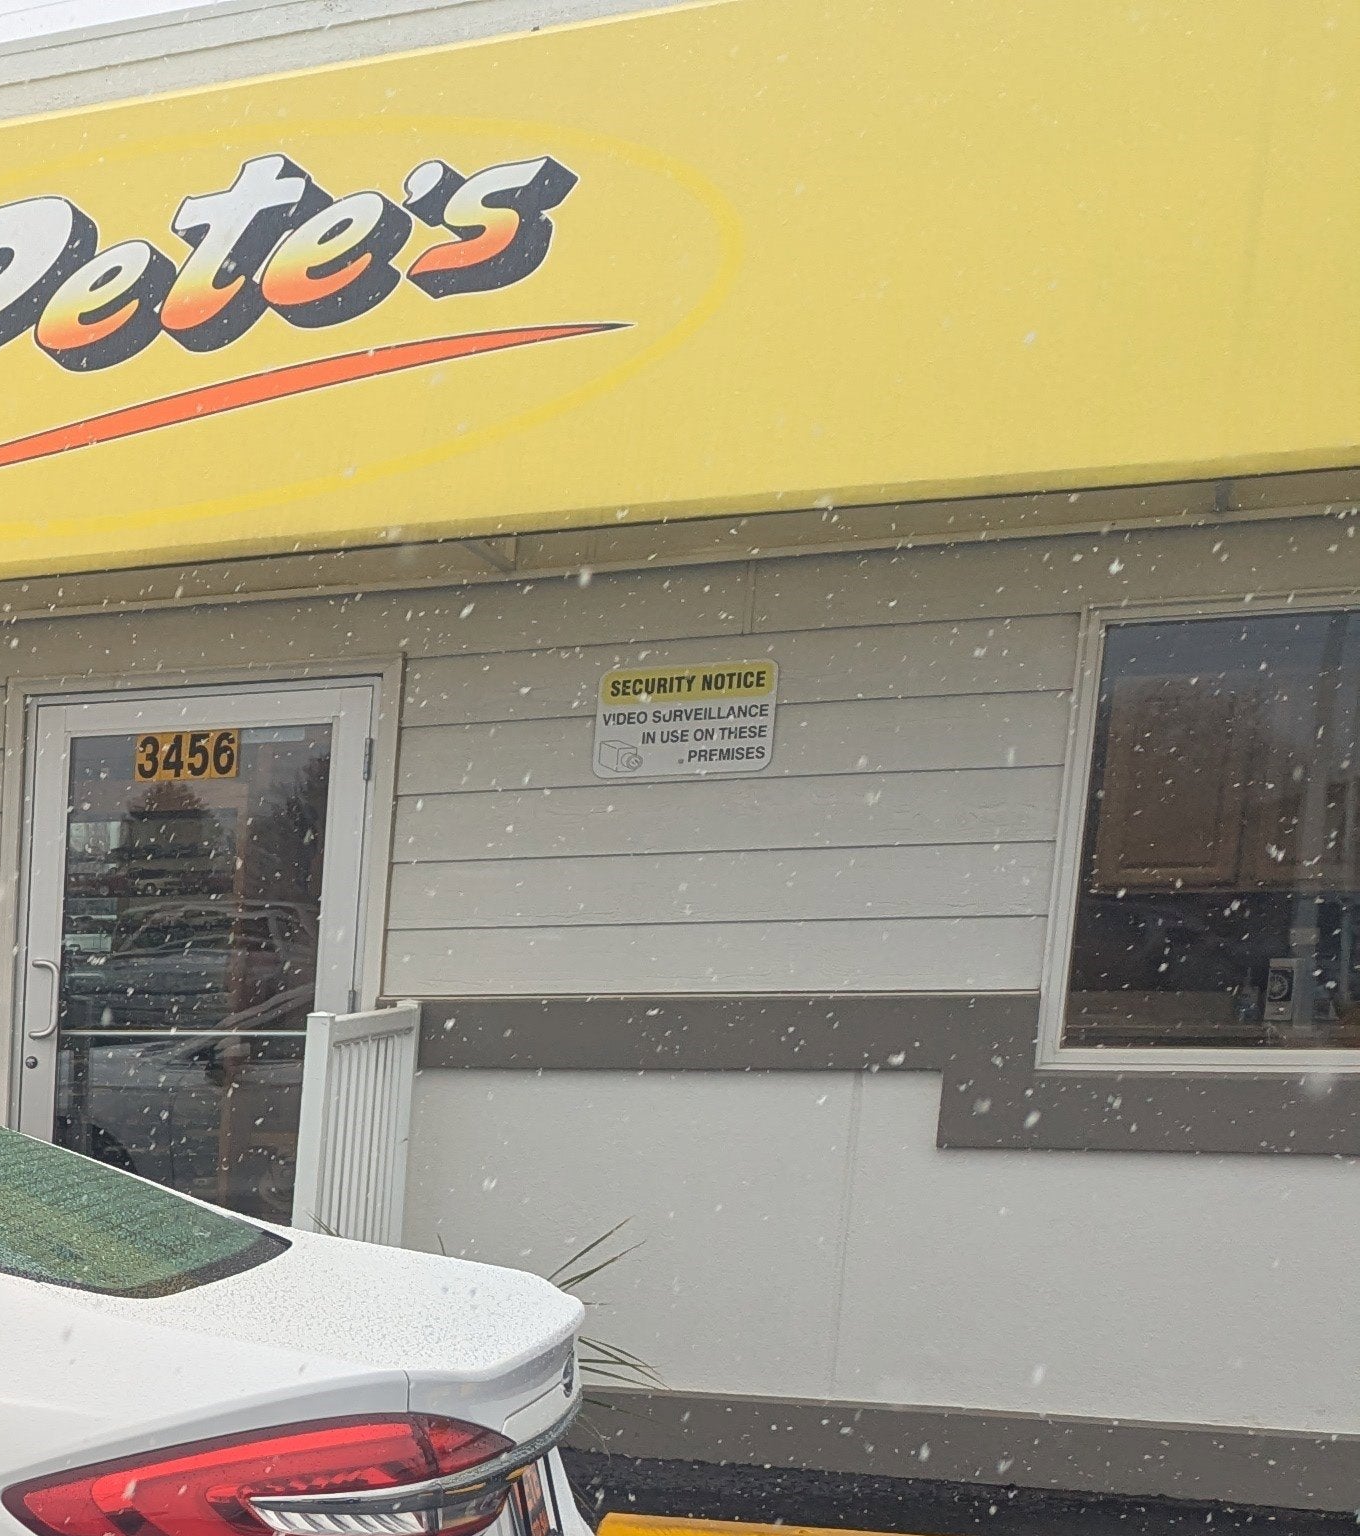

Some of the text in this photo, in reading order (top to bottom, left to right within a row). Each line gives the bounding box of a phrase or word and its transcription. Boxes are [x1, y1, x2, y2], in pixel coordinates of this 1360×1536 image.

[610, 671, 767, 697] SECURITY NOTICE
[603, 704, 770, 726] VIDEO SURVEILLANCE
[641, 725, 768, 745] IN USE ON THESE
[137, 731, 237, 779] 3456
[688, 745, 766, 763] PREMISES
